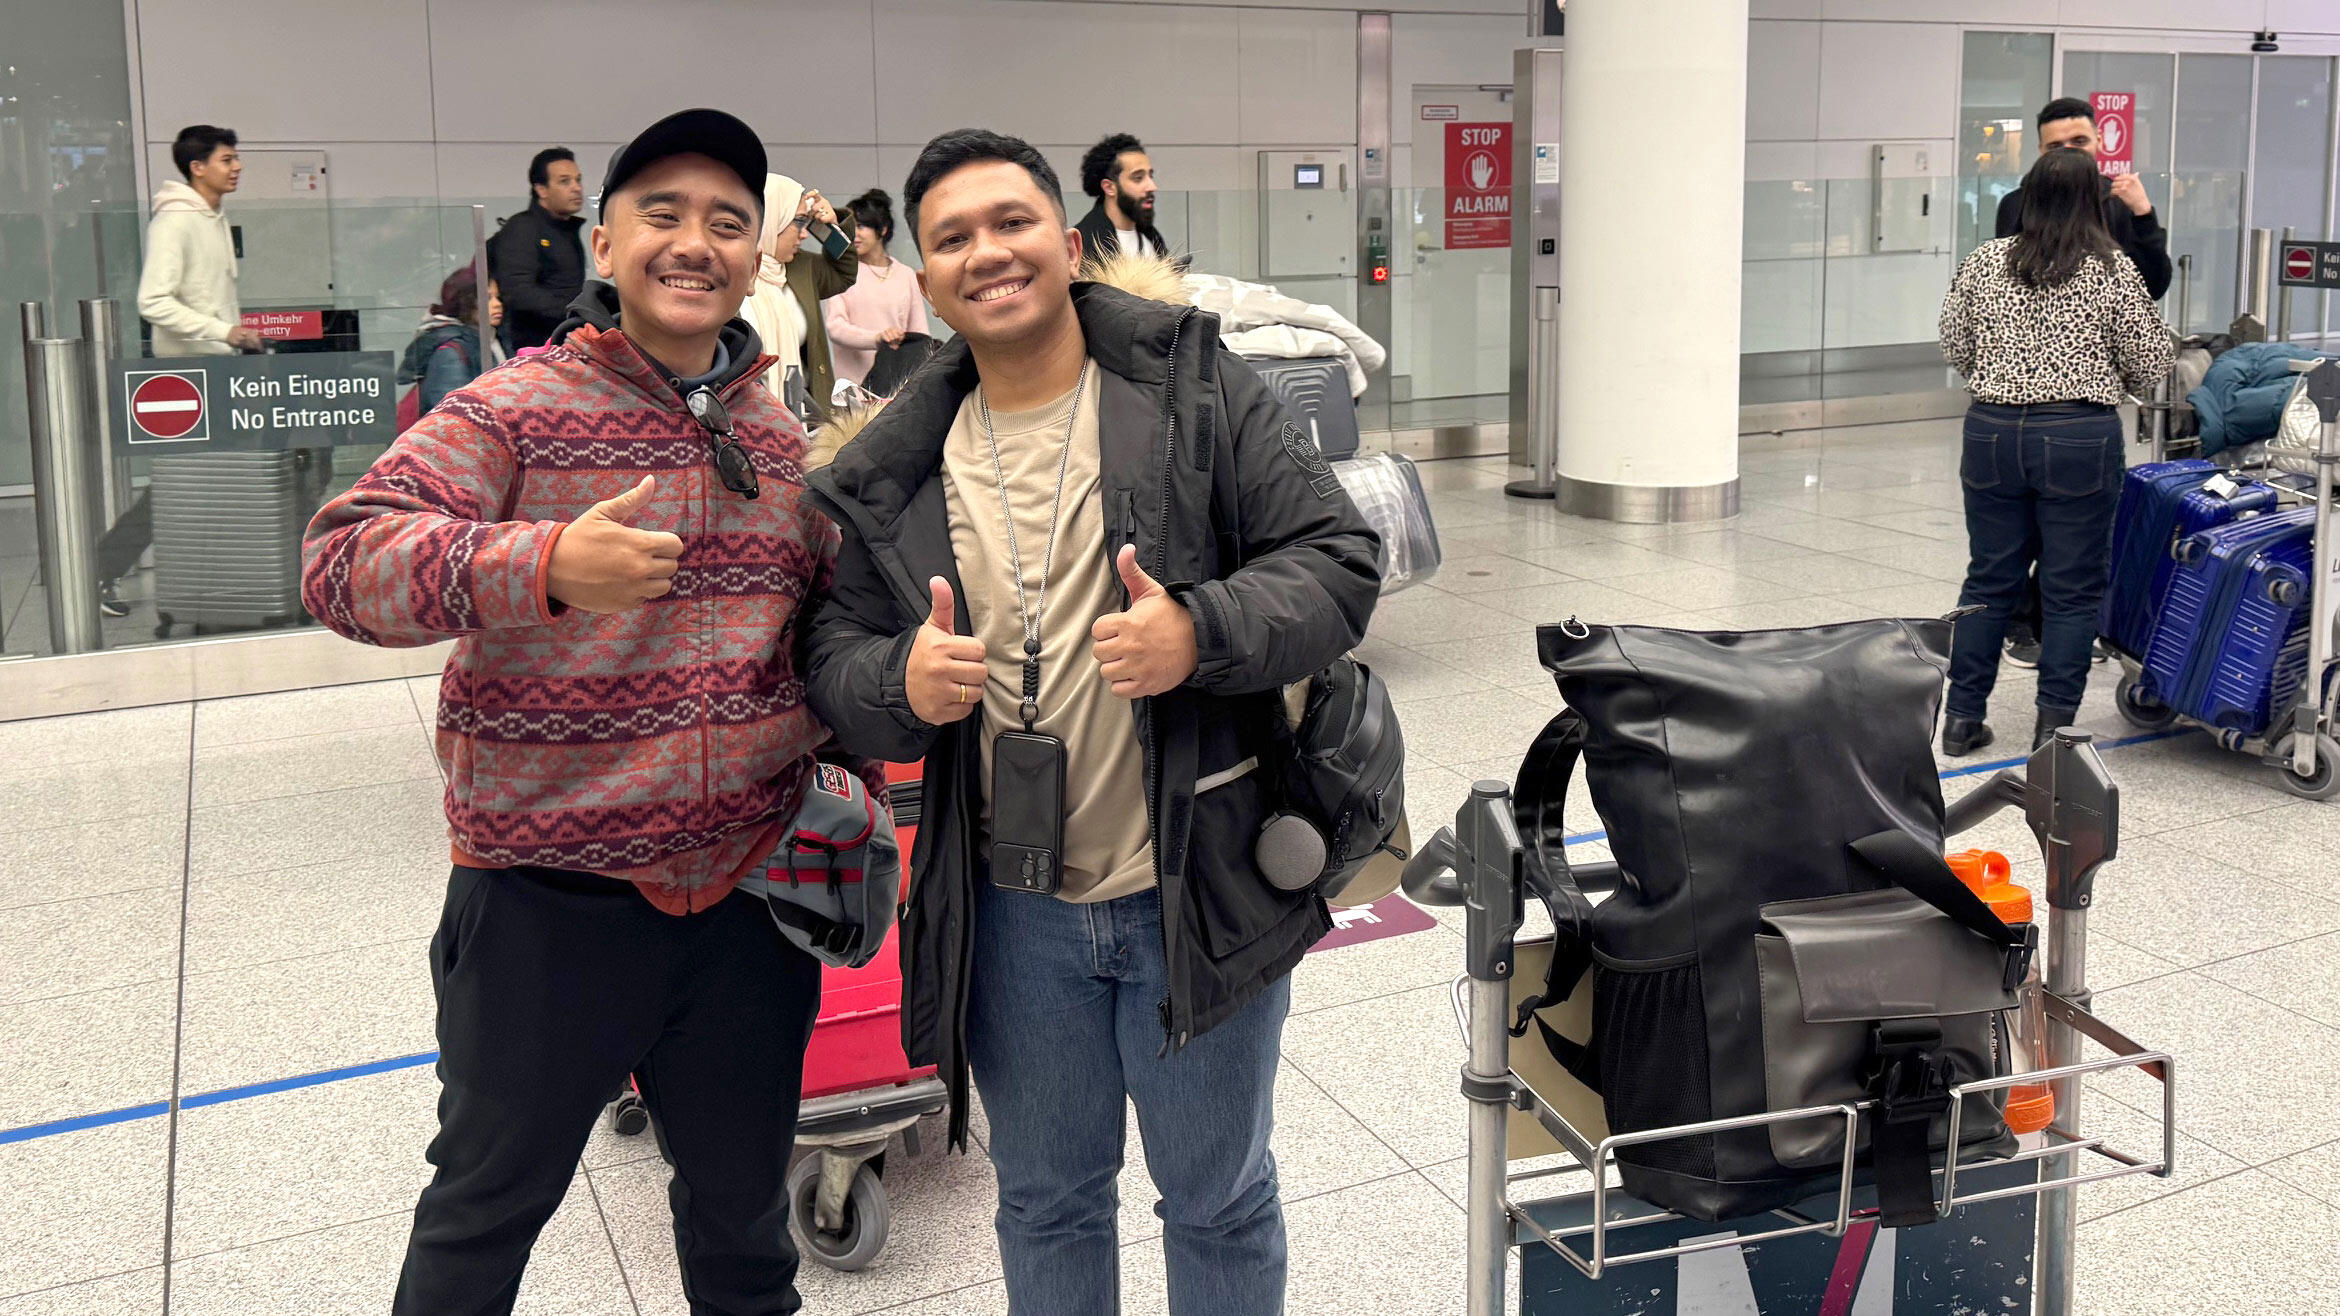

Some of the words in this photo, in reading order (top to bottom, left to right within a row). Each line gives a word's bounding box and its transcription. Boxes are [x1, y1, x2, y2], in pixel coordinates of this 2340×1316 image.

[2097, 94, 2129, 110] STOP
[1461, 128, 1502, 146] STOP
[2096, 160, 2131, 175] LARM
[1453, 195, 1508, 214] ALARM
[2323, 267, 2338, 280] No
[240, 315, 259, 326] ine
[261, 314, 304, 325] Umkehr
[229, 375, 281, 398] Kein
[288, 374, 380, 399] Eingang
[231, 408, 265, 430] No
[272, 407, 375, 428] Entrance
